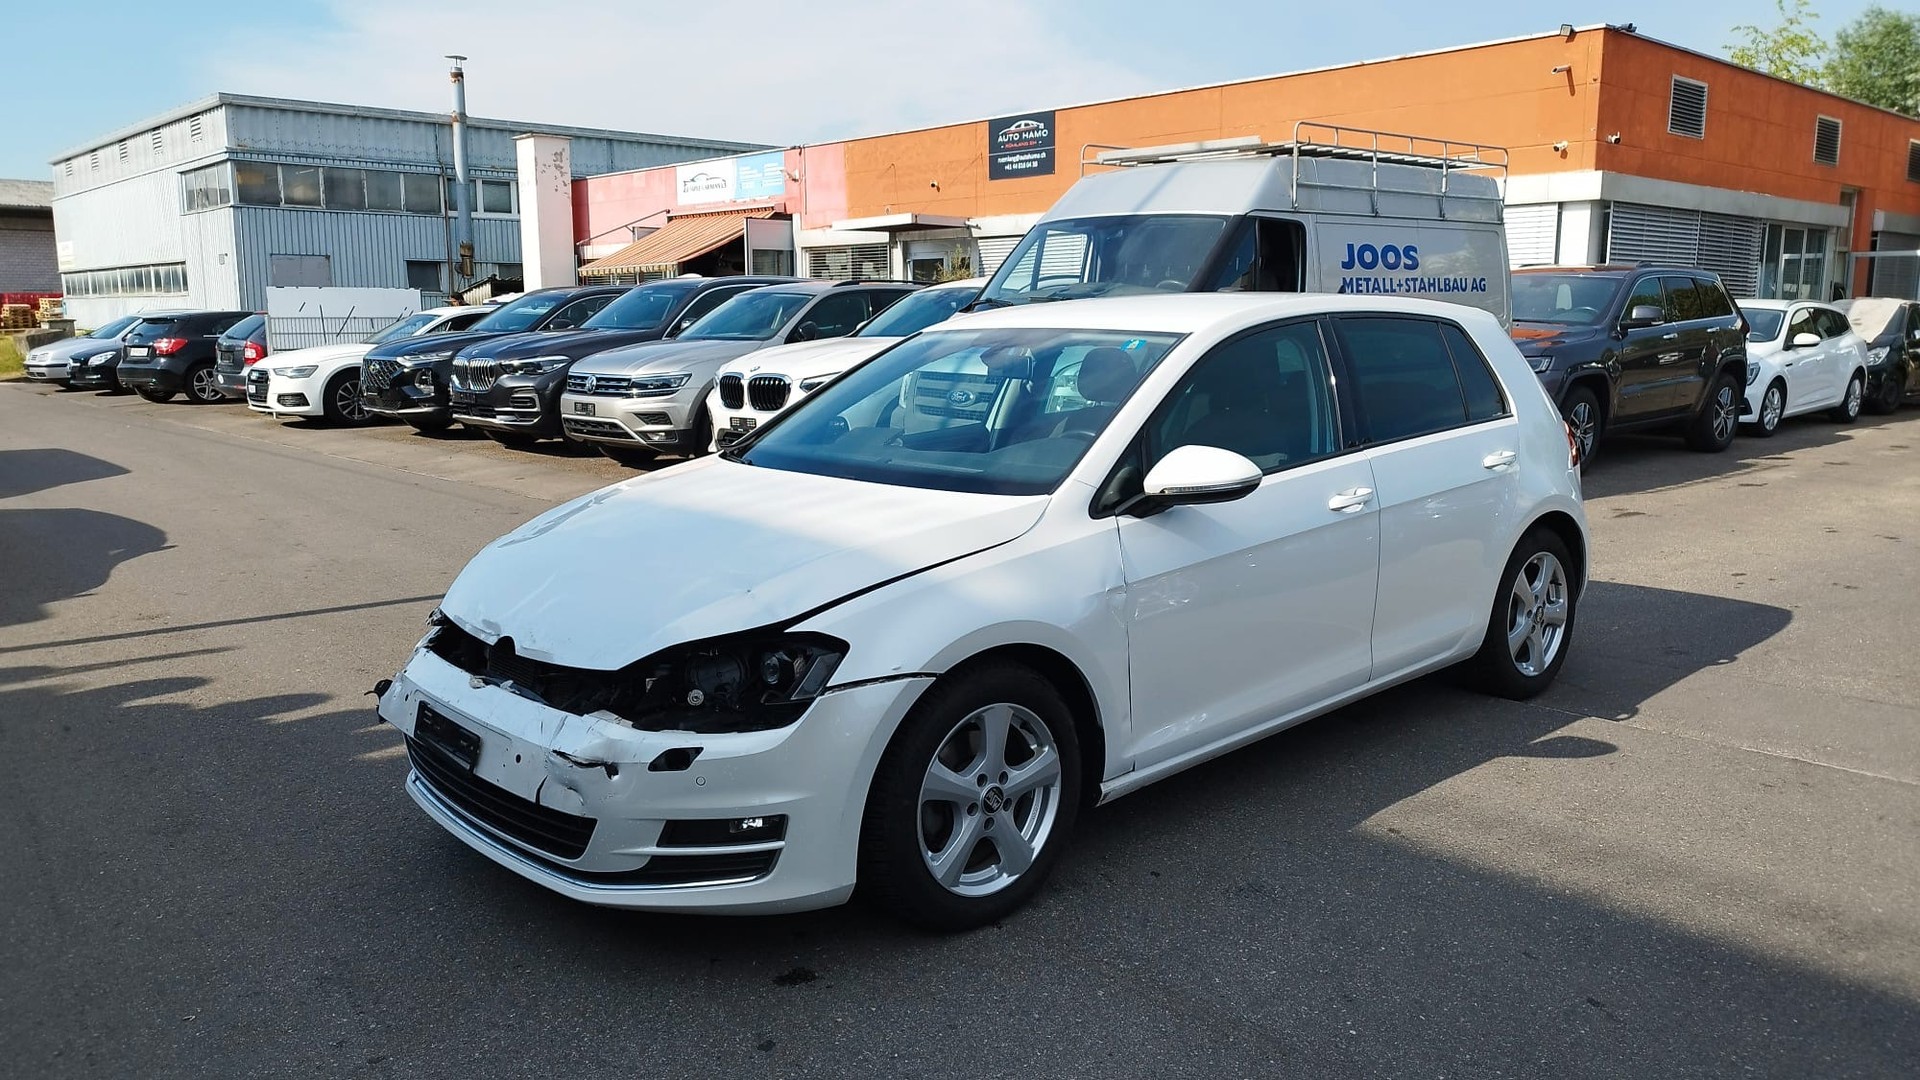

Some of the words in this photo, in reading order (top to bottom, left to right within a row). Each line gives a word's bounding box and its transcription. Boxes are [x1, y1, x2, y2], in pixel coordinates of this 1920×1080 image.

[998, 133, 1020, 143] AUTO
[1022, 130, 1048, 139] HAMO
[1341, 243, 1420, 271] JOOS
[1342, 276, 1468, 294] METALL+STAHLBAU
[1470, 277, 1487, 293] AG
